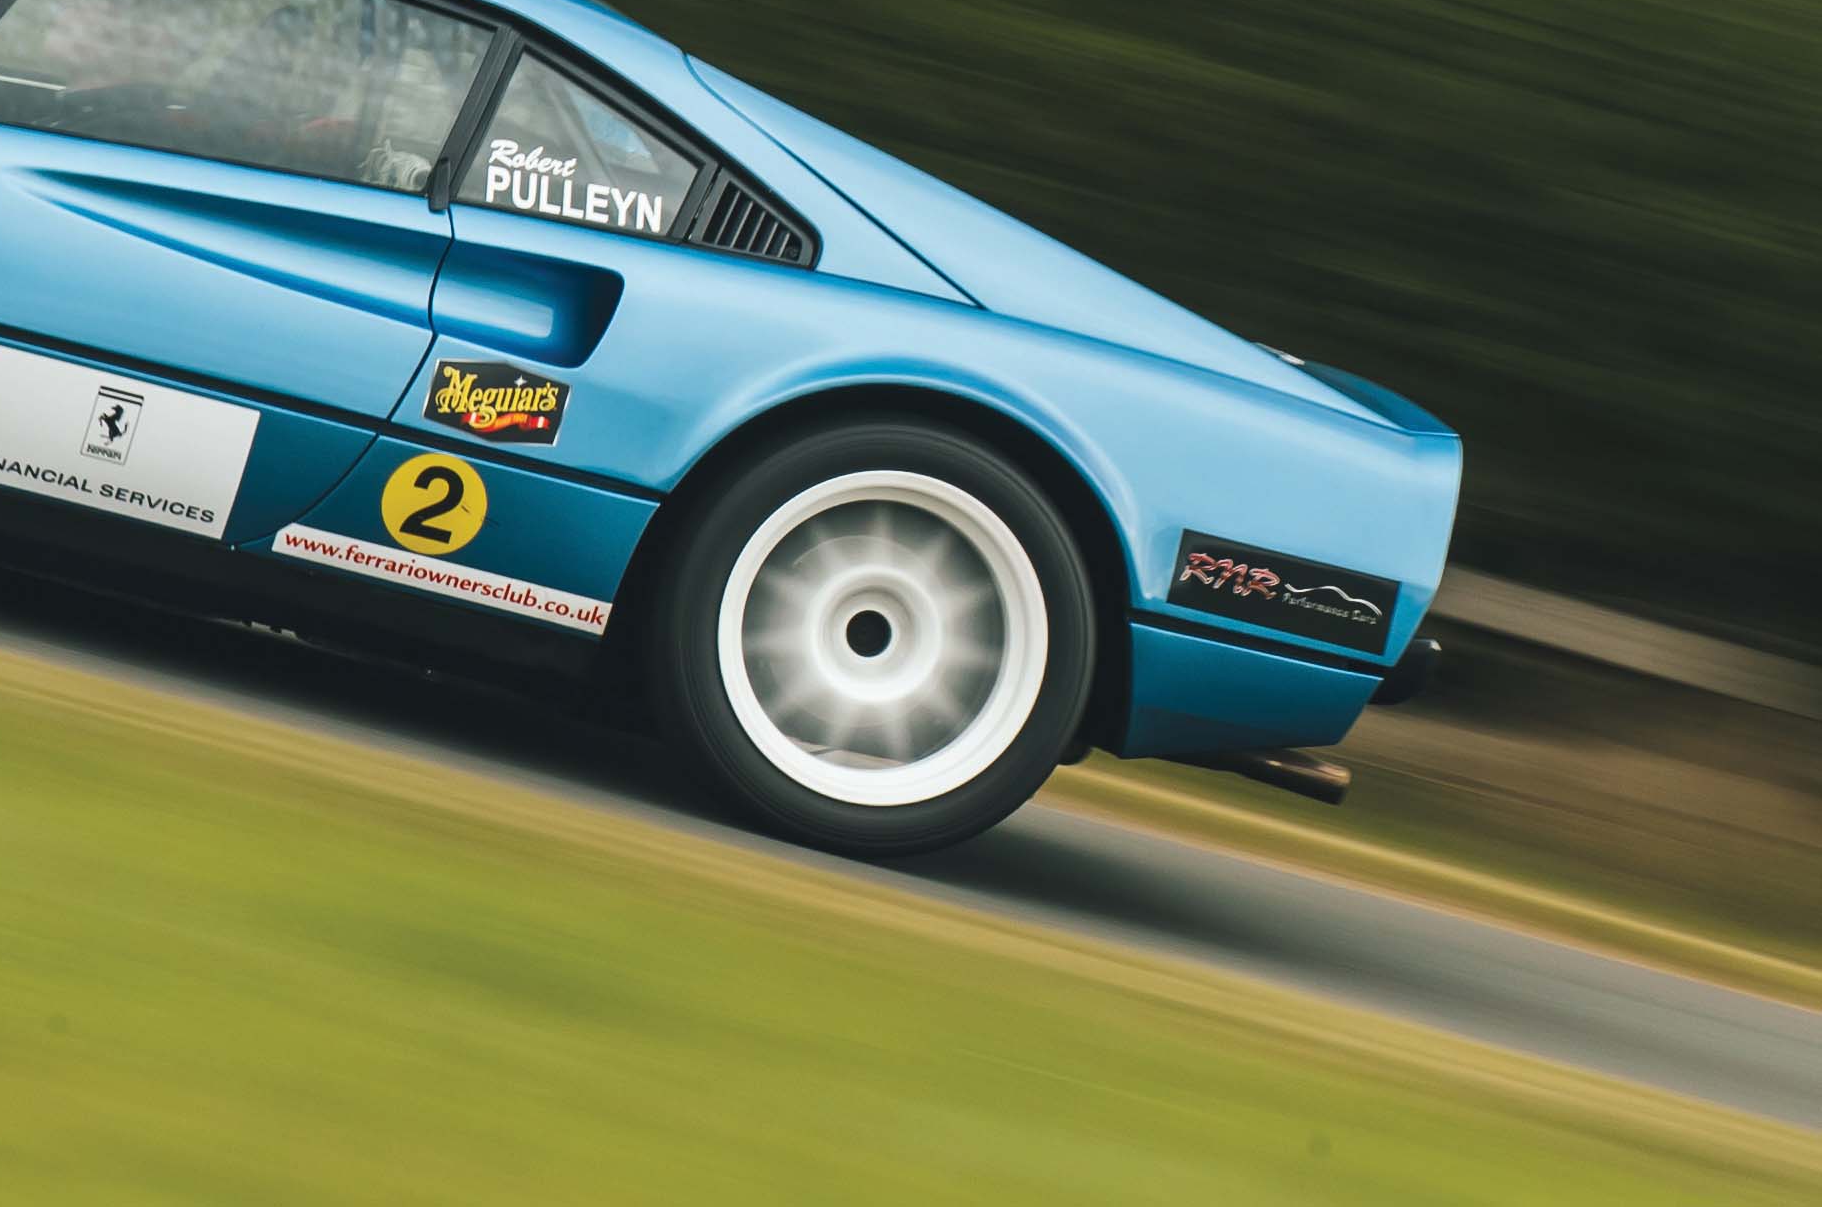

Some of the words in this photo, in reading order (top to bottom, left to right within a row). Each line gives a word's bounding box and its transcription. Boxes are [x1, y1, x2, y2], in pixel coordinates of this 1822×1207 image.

[488, 139, 577, 177] Robert
[485, 165, 662, 233] PULLEYN
[435, 366, 559, 428] Meguiar's
[98, 484, 215, 523] SERVICES
[399, 465, 464, 544] 2
[285, 533, 604, 626] www.ferrariownersclub.co.uk
